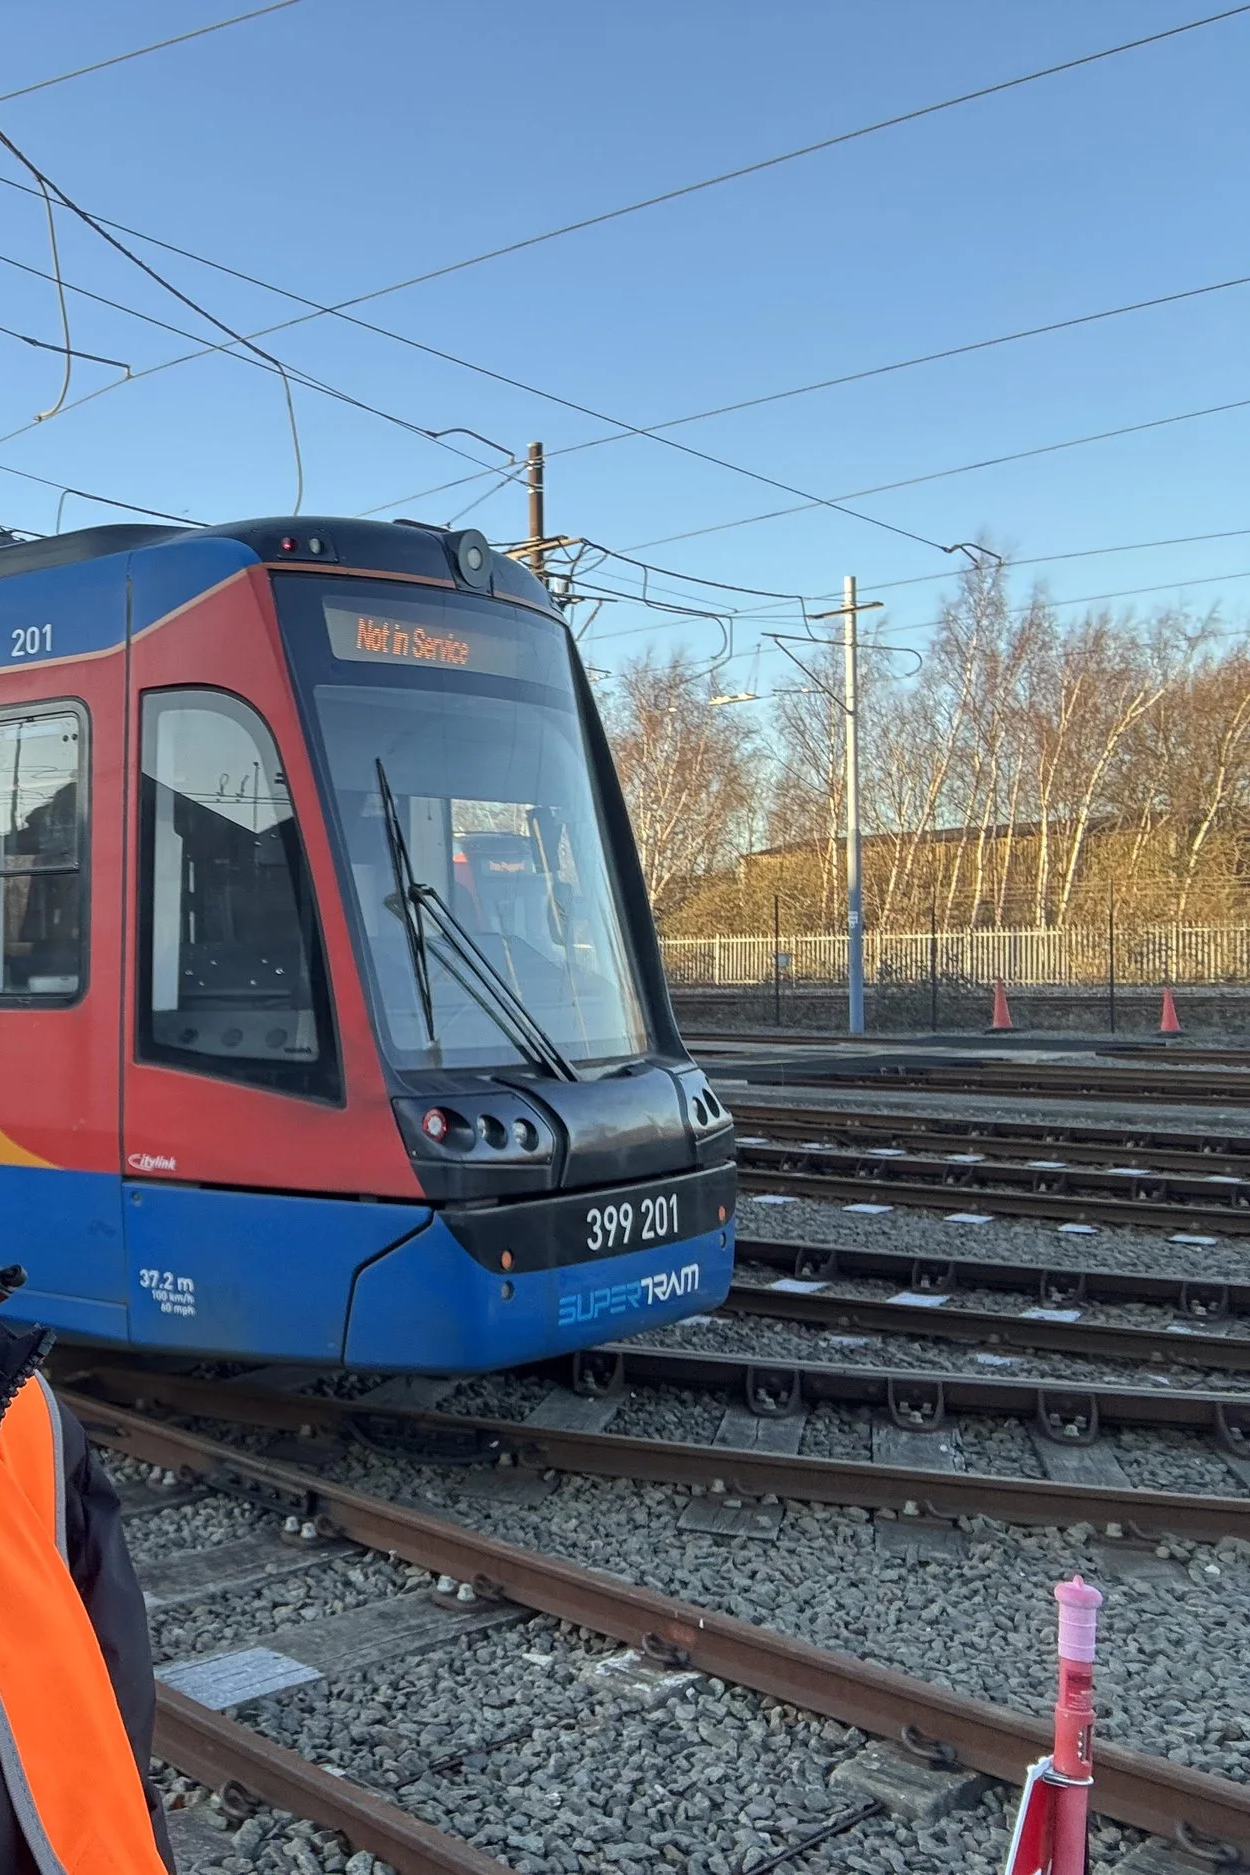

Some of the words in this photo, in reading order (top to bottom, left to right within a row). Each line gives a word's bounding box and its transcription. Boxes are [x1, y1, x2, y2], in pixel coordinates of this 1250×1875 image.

[11, 623, 52, 657] 201
[356, 618, 389, 653] Not
[392, 624, 409, 656] in
[412, 628, 468, 665] Service
[127, 1153, 177, 1172] Citylink
[586, 1202, 633, 1250] 399
[640, 1193, 678, 1240] 201
[139, 1269, 174, 1290] 37.2
[177, 1276, 195, 1292] m
[558, 1263, 700, 1326] SUPERTRAM
[151, 1289, 168, 1301] 100
[169, 1291, 195, 1304] km/h
[161, 1303, 173, 1314] 60
[173, 1305, 196, 1317] mph
